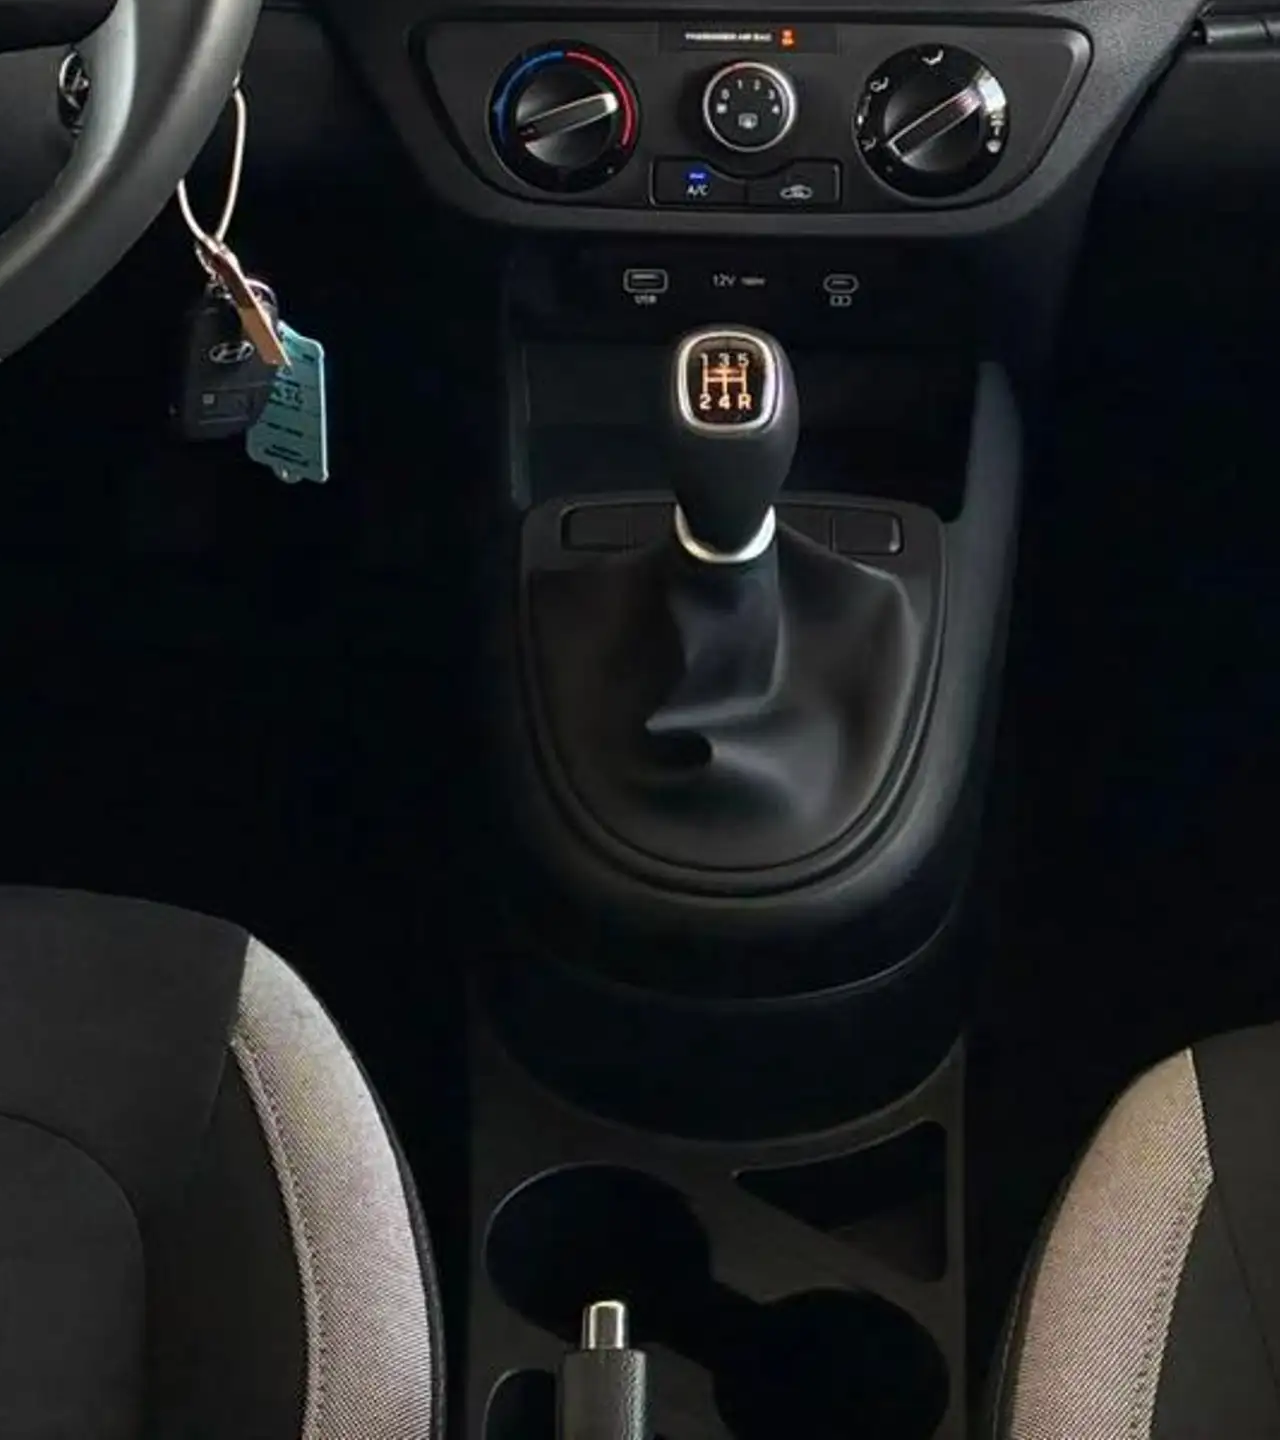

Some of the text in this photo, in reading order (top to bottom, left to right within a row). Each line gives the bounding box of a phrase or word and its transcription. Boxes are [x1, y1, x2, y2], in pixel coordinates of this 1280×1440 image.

[736, 78, 743, 90] 1
[753, 78, 761, 91] 2
[686, 184, 709, 198] A/C
[700, 351, 750, 367] 1 3 5
[699, 392, 752, 410] 2 4 R
